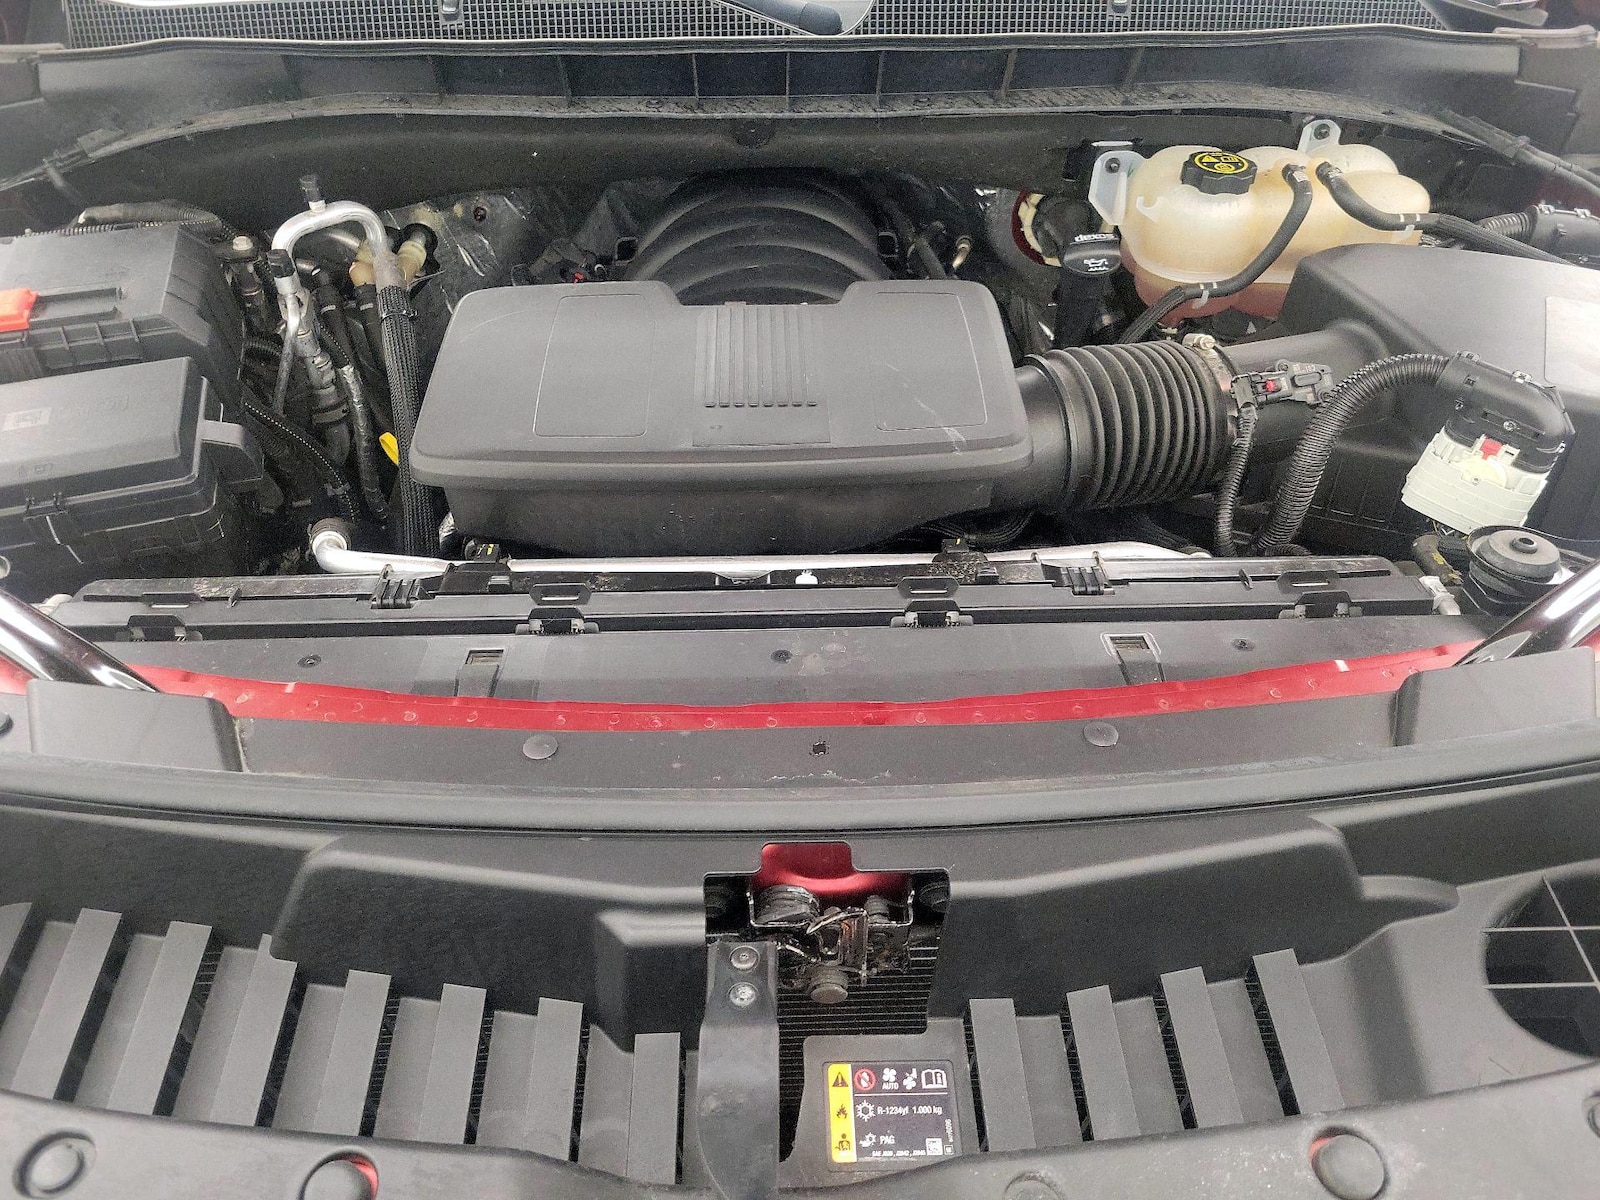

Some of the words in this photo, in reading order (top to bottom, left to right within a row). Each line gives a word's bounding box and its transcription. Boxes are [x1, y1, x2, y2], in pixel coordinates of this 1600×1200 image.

[882, 1082, 899, 1090] AUTO
[912, 1106, 932, 1114] 1.000
[933, 1106, 943, 1115] kg
[879, 1135, 895, 1145] PAG
